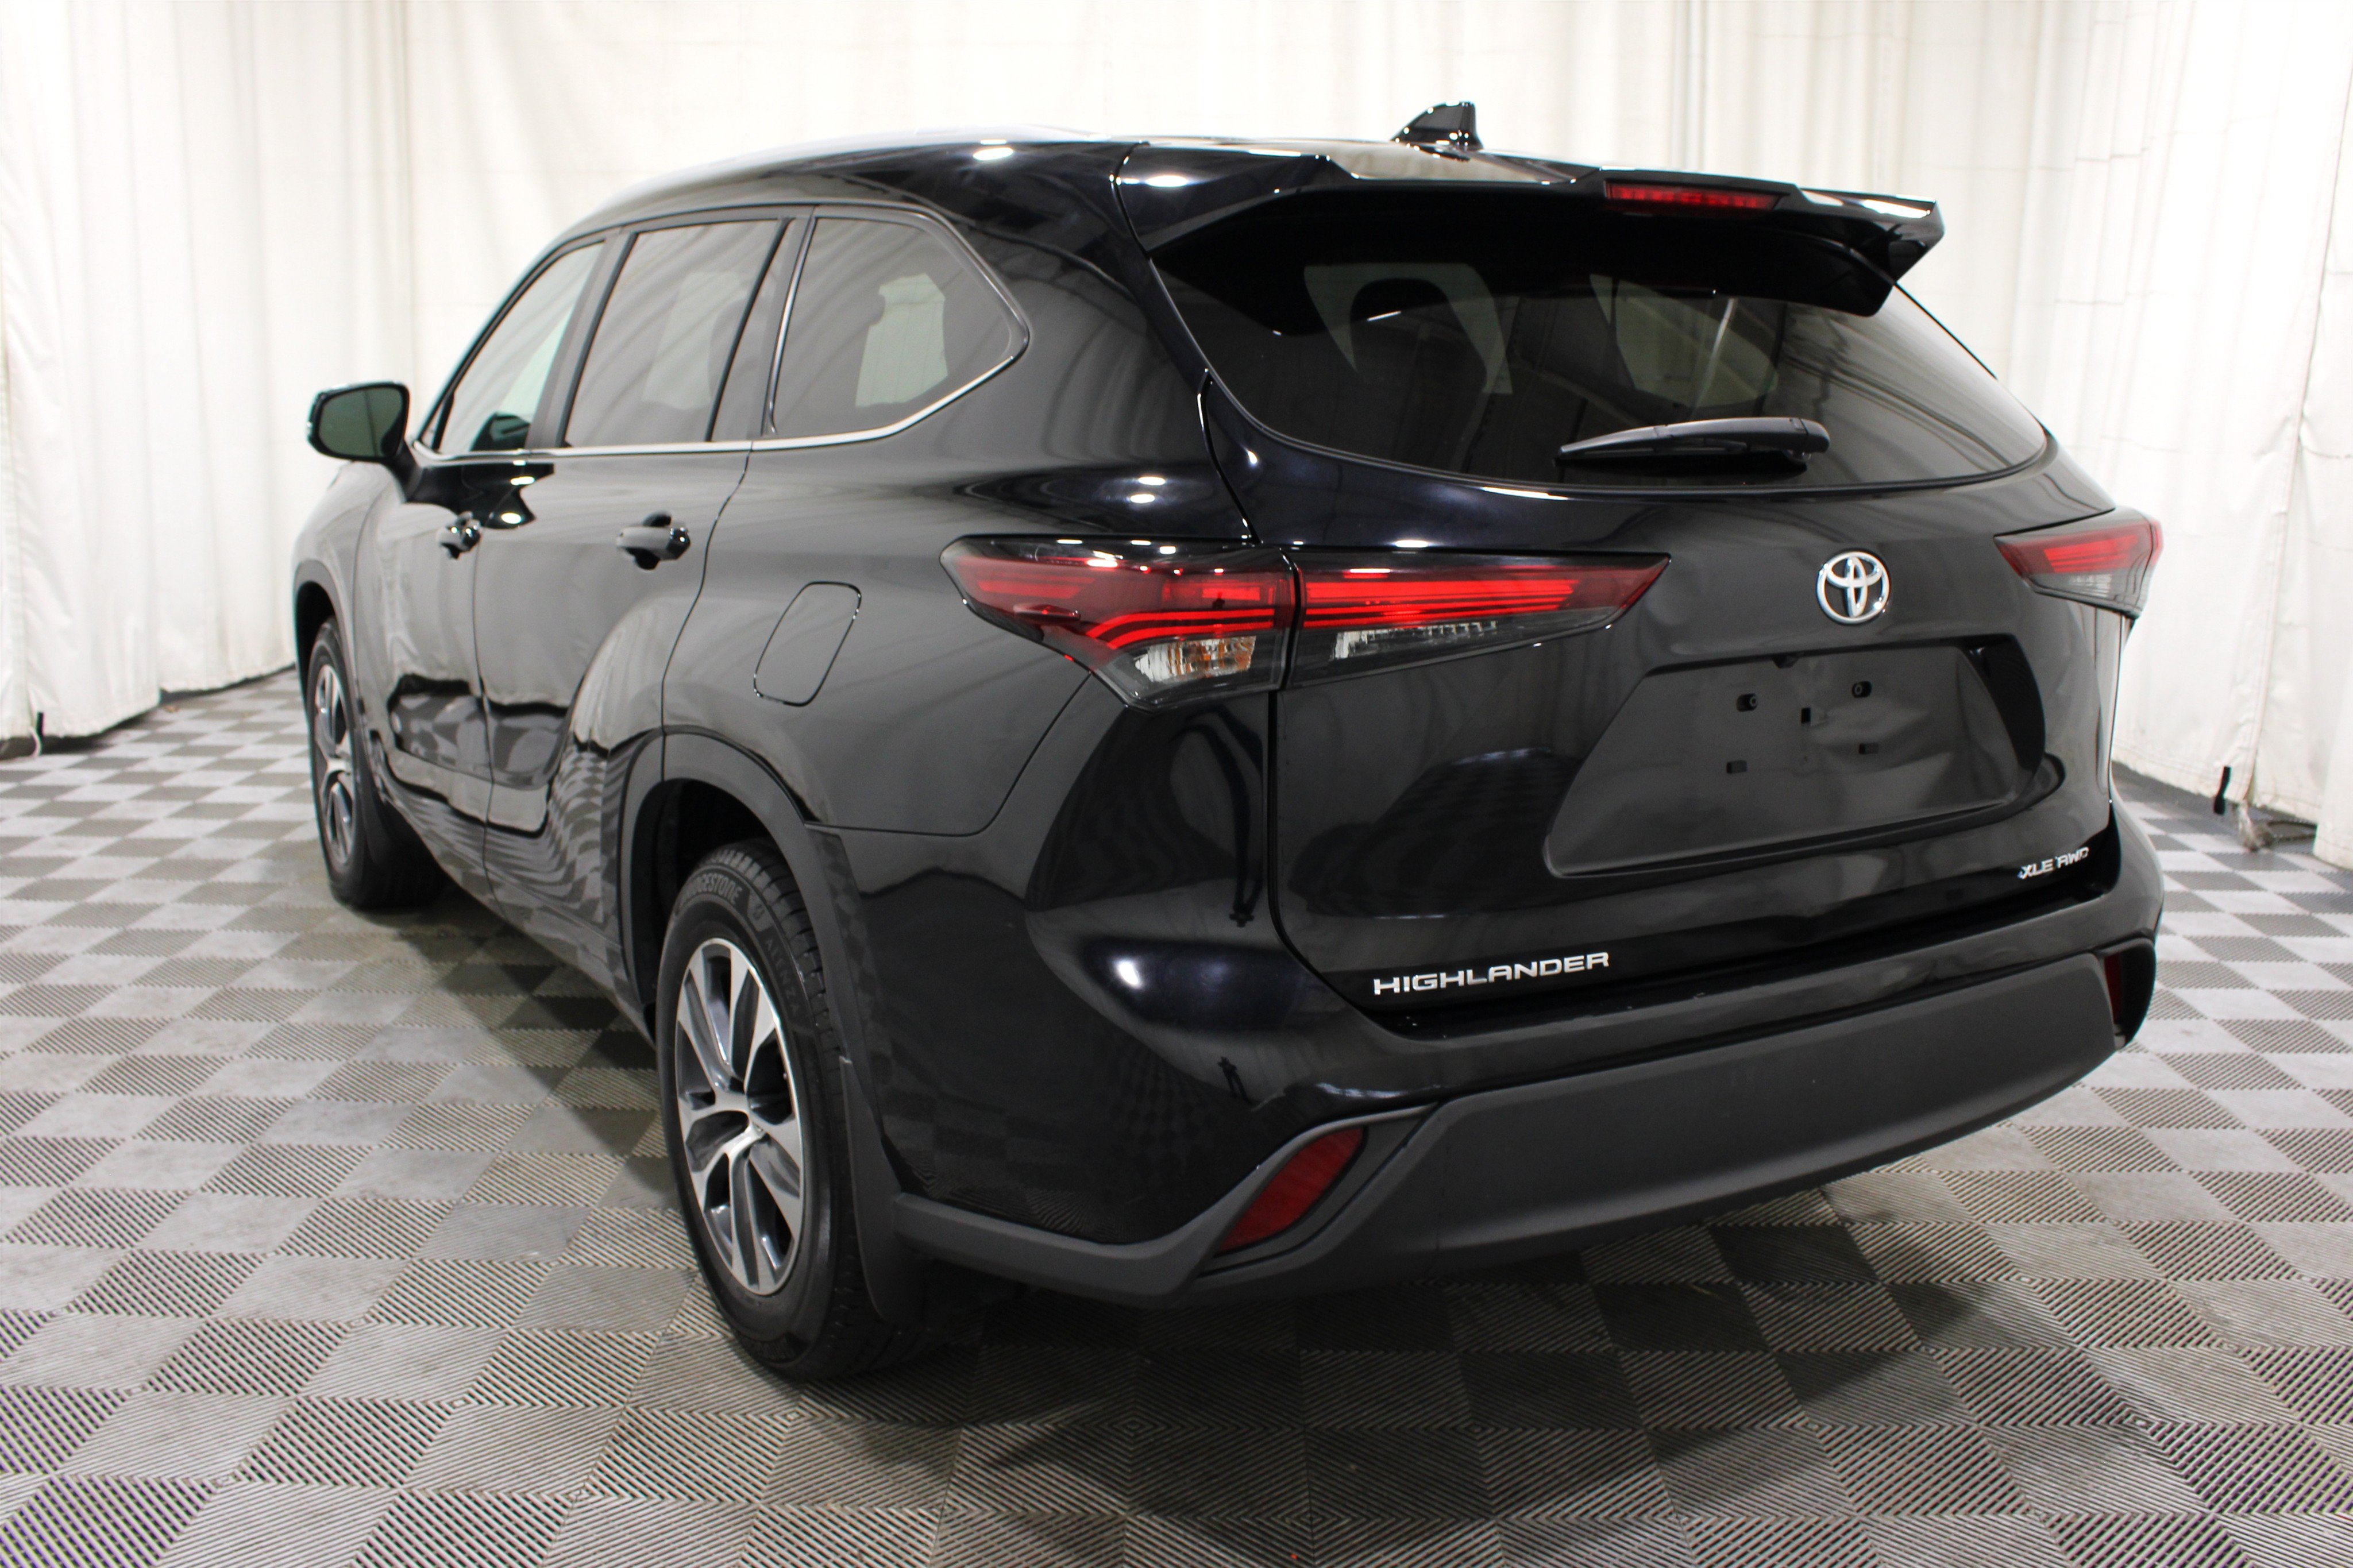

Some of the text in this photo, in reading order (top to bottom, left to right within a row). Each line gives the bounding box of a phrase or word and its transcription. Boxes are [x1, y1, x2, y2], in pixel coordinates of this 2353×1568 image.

[2017, 847, 2089, 879] XLE AWD
[680, 872, 742, 907] ESTONE
[1374, 952, 1609, 995] HIGHLANDER
